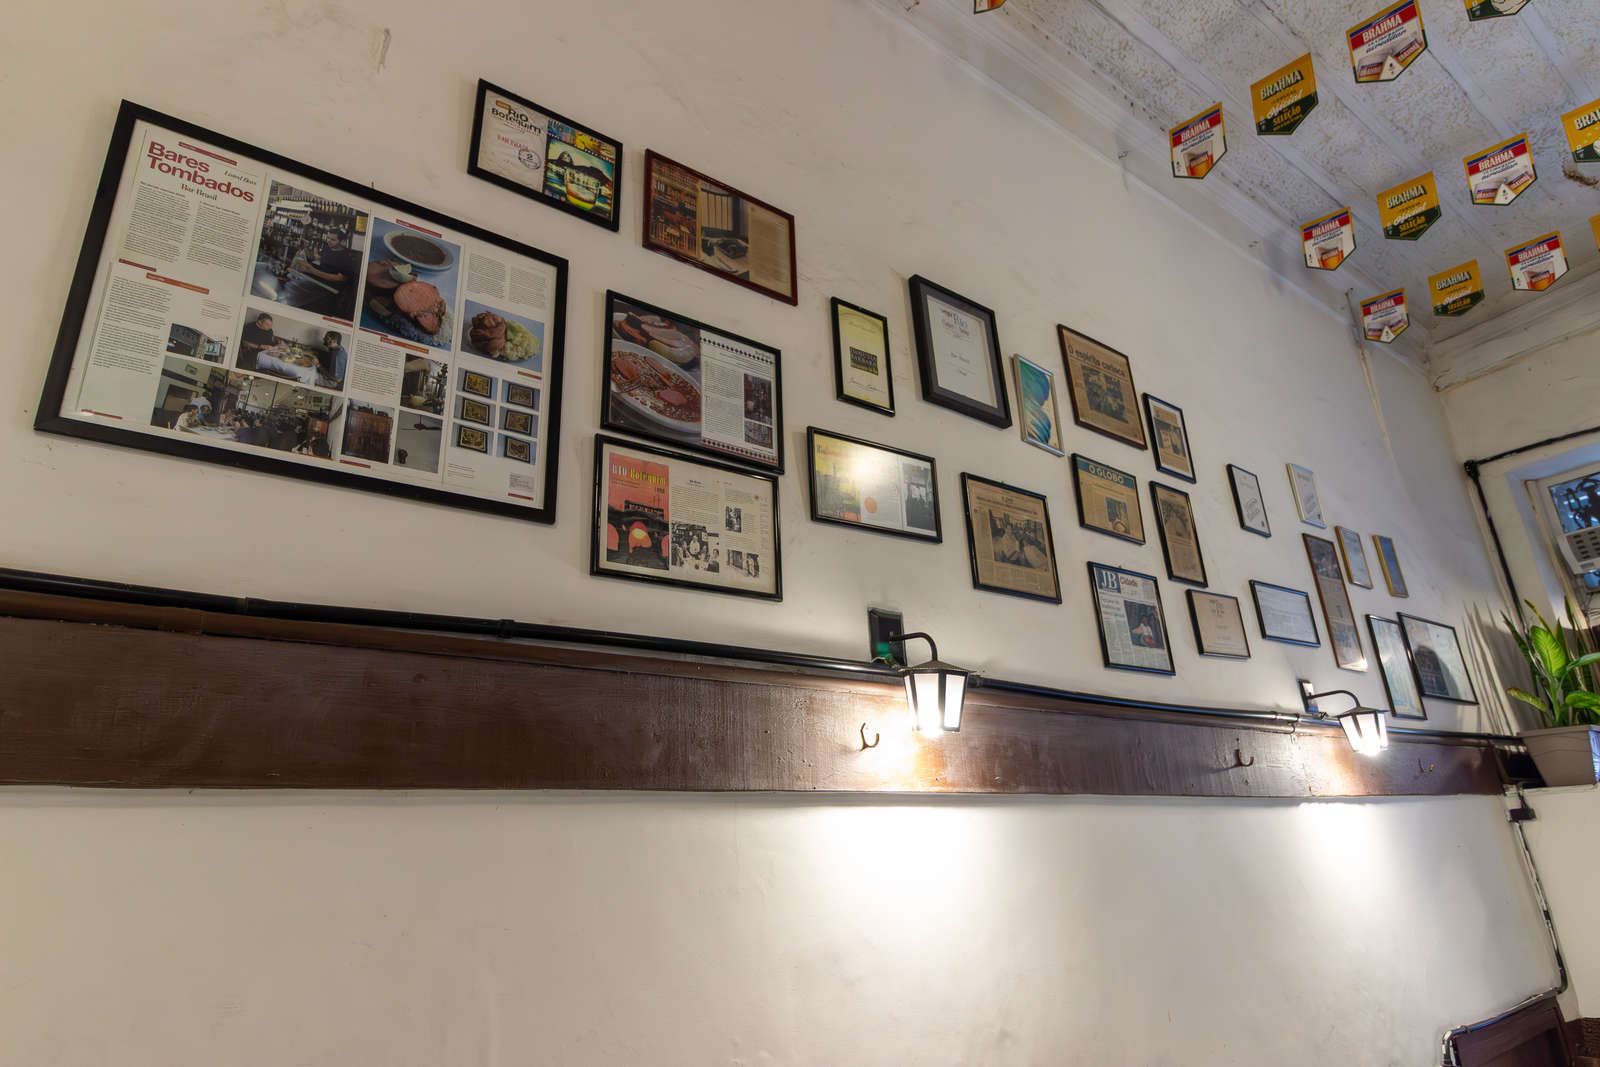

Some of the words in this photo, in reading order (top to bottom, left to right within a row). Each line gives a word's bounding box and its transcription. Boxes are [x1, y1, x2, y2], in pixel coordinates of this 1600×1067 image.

[1362, 15, 1402, 44] BRAHMA
[1261, 70, 1304, 101] BRAHMA
[1574, 109, 1600, 130] BRA
[1182, 119, 1210, 142] BRAHMA
[149, 141, 210, 173] Bares
[1478, 150, 1514, 171] BRAHMA
[148, 153, 255, 202] Tombados
[1386, 185, 1426, 209] BRAHMA
[1312, 219, 1340, 238] BRAHMA
[1519, 243, 1549, 262] BRAHMA
[1436, 272, 1471, 291] BRAHMA
[1097, 466, 1124, 484] GLOBO
[1102, 570, 1118, 589] JB
